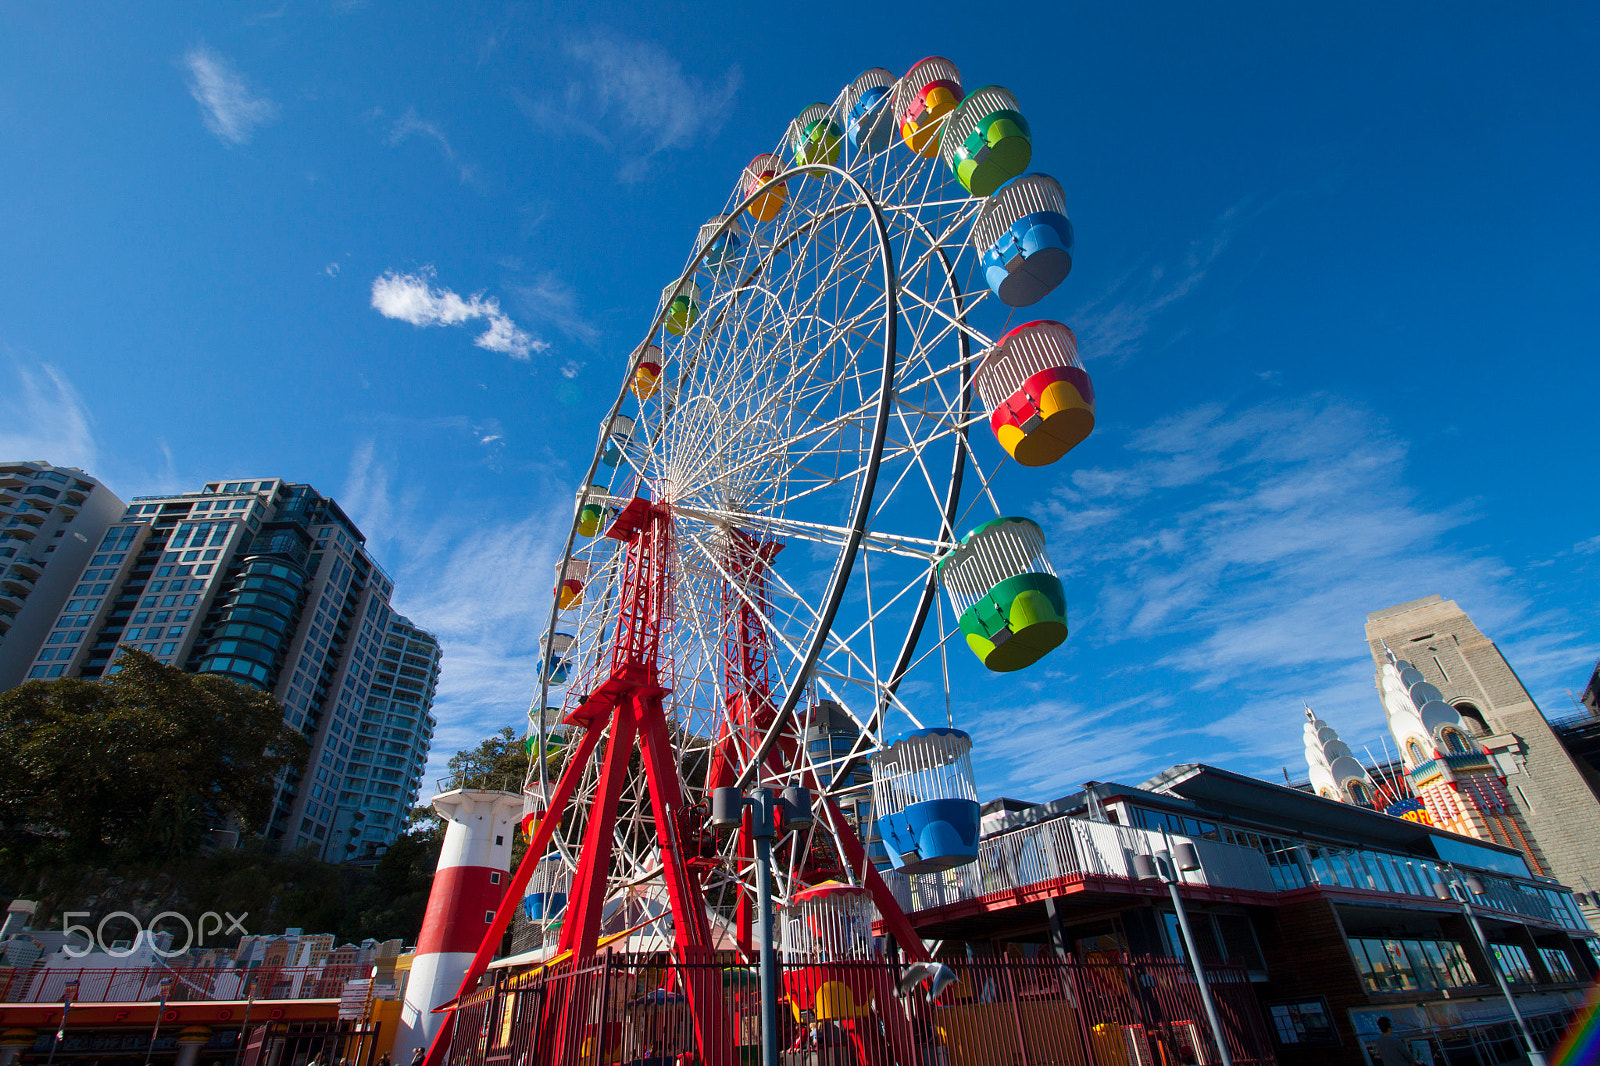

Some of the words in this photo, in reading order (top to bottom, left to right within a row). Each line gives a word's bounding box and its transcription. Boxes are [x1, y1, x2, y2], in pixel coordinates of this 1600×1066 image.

[1400, 811, 1418, 823] OR
[1417, 809, 1434, 826] FU
[114, 1008, 283, 1022] FOOD
